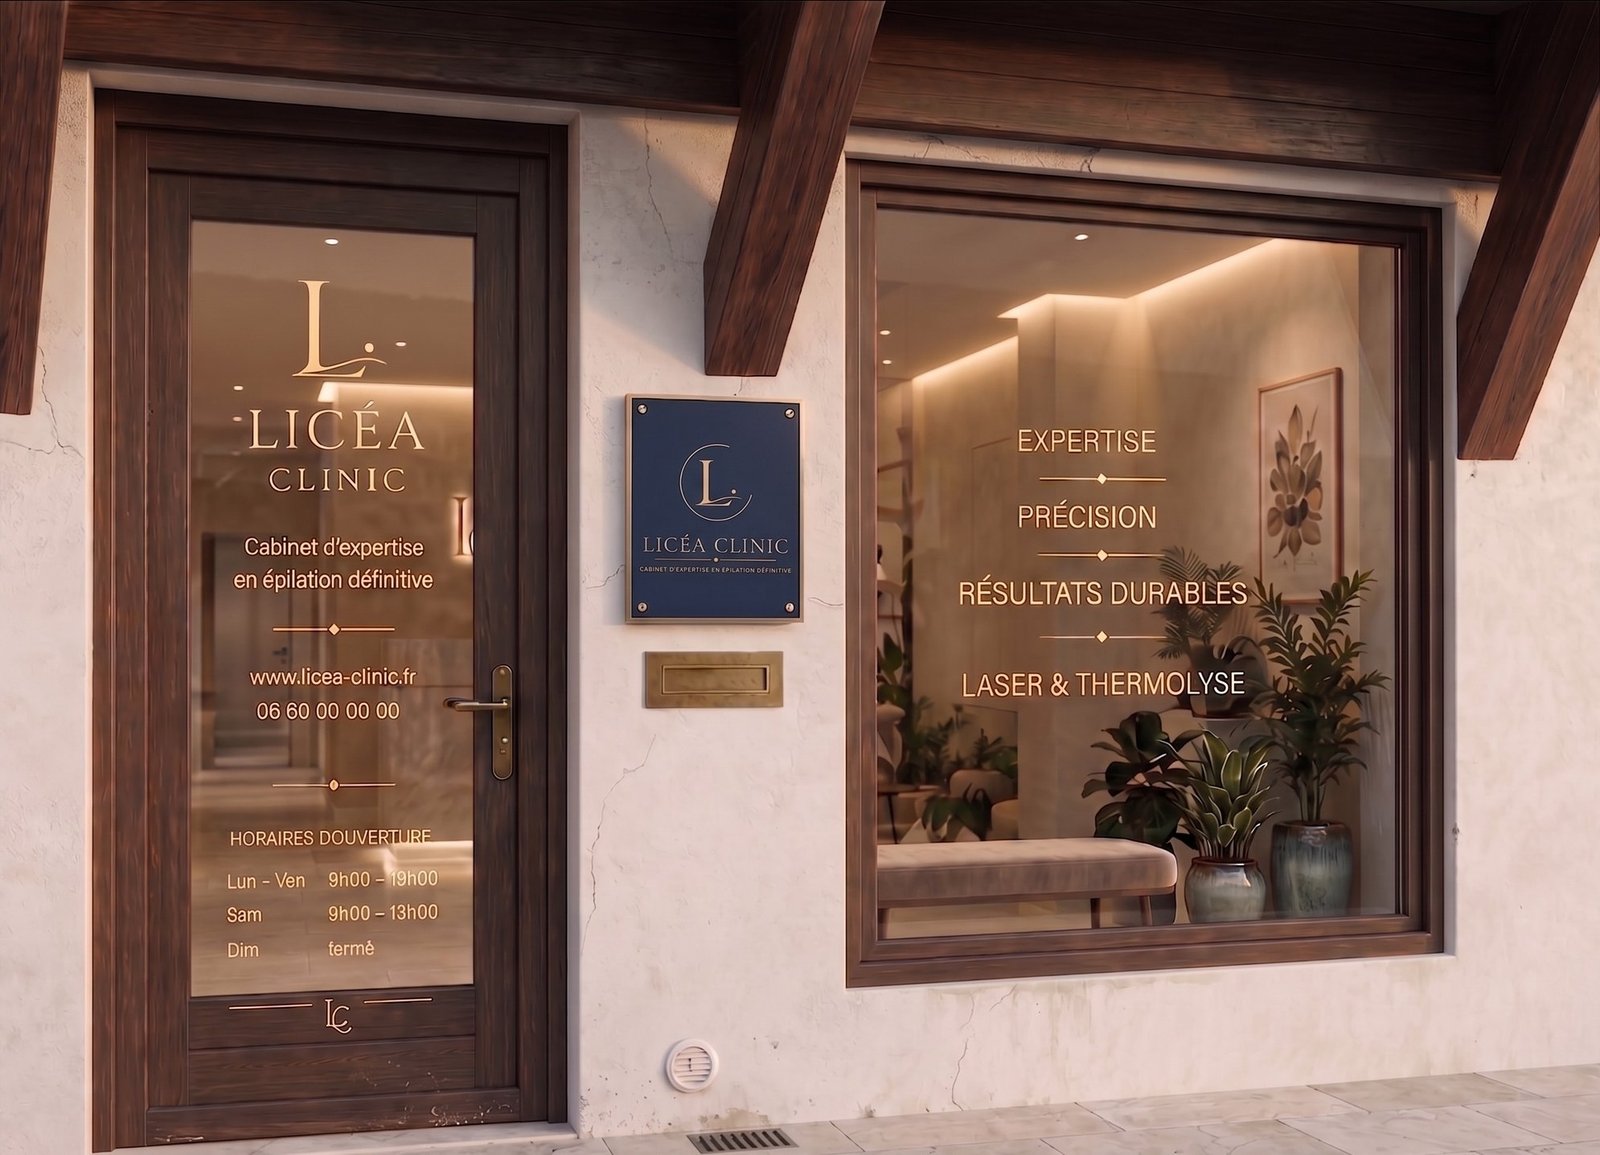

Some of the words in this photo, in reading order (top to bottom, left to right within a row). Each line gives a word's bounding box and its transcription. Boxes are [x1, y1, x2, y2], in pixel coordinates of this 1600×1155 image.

[249, 400, 425, 450] LICÉA
[1018, 429, 1156, 453] EXPERTISE
[269, 467, 406, 492] CLINIC
[1018, 499, 1157, 529] PRÉCISION
[244, 537, 319, 557] Cabinet
[643, 533, 706, 554] LICÉA
[714, 537, 789, 555] CLINIC
[233, 573, 257, 589] en
[262, 569, 342, 592] épilation
[348, 570, 433, 590] définitive
[721, 566, 755, 574] ÉPILATION
[756, 566, 792, 574] DÉFINITIVE
[959, 574, 1103, 605] RÉSULTATS
[1111, 582, 1248, 605] DURABLES
[250, 667, 417, 686] www.licea-clinic.fr
[963, 672, 1042, 697] LASER
[1050, 673, 1069, 696] &
[1075, 672, 1246, 696] THERMOLYSE
[256, 703, 281, 720] 06
[286, 703, 310, 720] 60
[315, 703, 340, 720] 00
[345, 703, 370, 719] 00
[375, 703, 400, 720] 00
[230, 831, 314, 846] HORAIRES
[319, 829, 432, 845] DOUVERTURE
[227, 874, 256, 889] Lun
[275, 872, 305, 888] Ven
[328, 871, 370, 887] 9h00
[390, 870, 439, 887] 19h00
[227, 907, 262, 922] Sam
[328, 905, 370, 921] 9h00
[389, 904, 438, 920] 13h00
[227, 943, 259, 957] Dim
[328, 940, 375, 956] fermé
